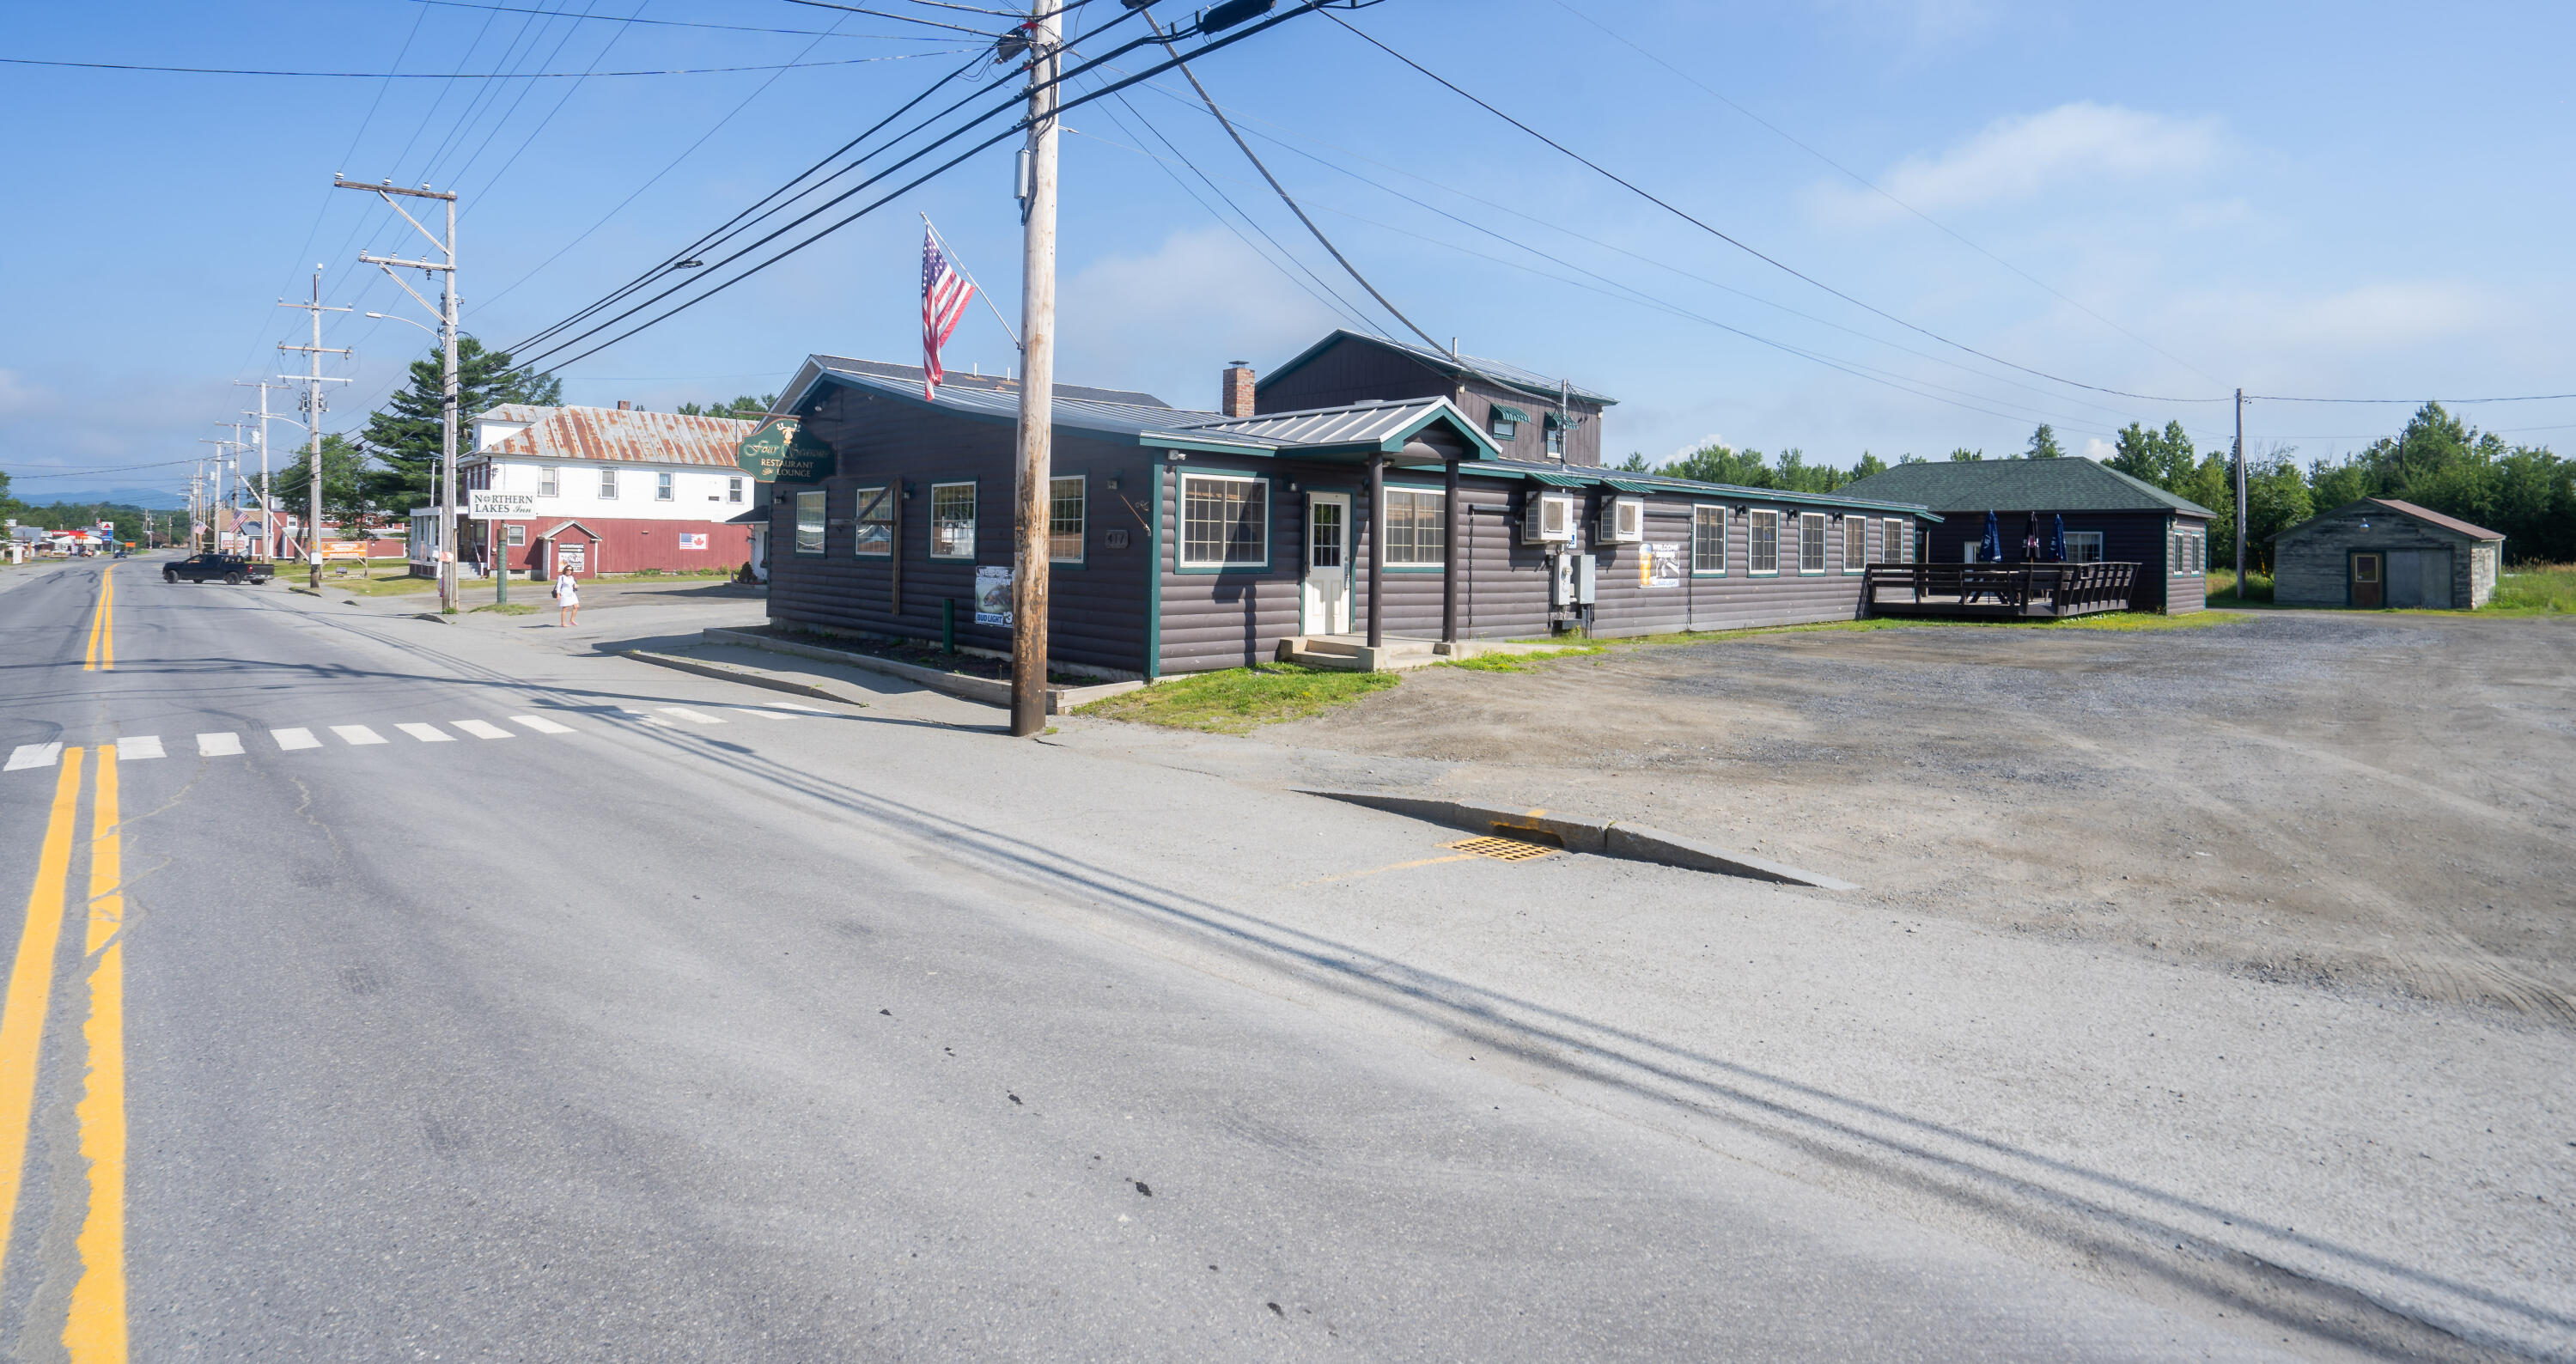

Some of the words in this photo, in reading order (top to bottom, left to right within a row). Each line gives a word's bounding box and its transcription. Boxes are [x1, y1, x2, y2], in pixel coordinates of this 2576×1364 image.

[744, 440, 779, 457] Four
[761, 458, 814, 469] RESTAURANT
[776, 468, 812, 478] LOUNGE
[474, 494, 533, 504] NORTHERN
[475, 503, 510, 513] LAKES
[513, 504, 532, 514] Inn
[977, 613, 988, 622] BUD
[988, 614, 1003, 624] LIGHT
